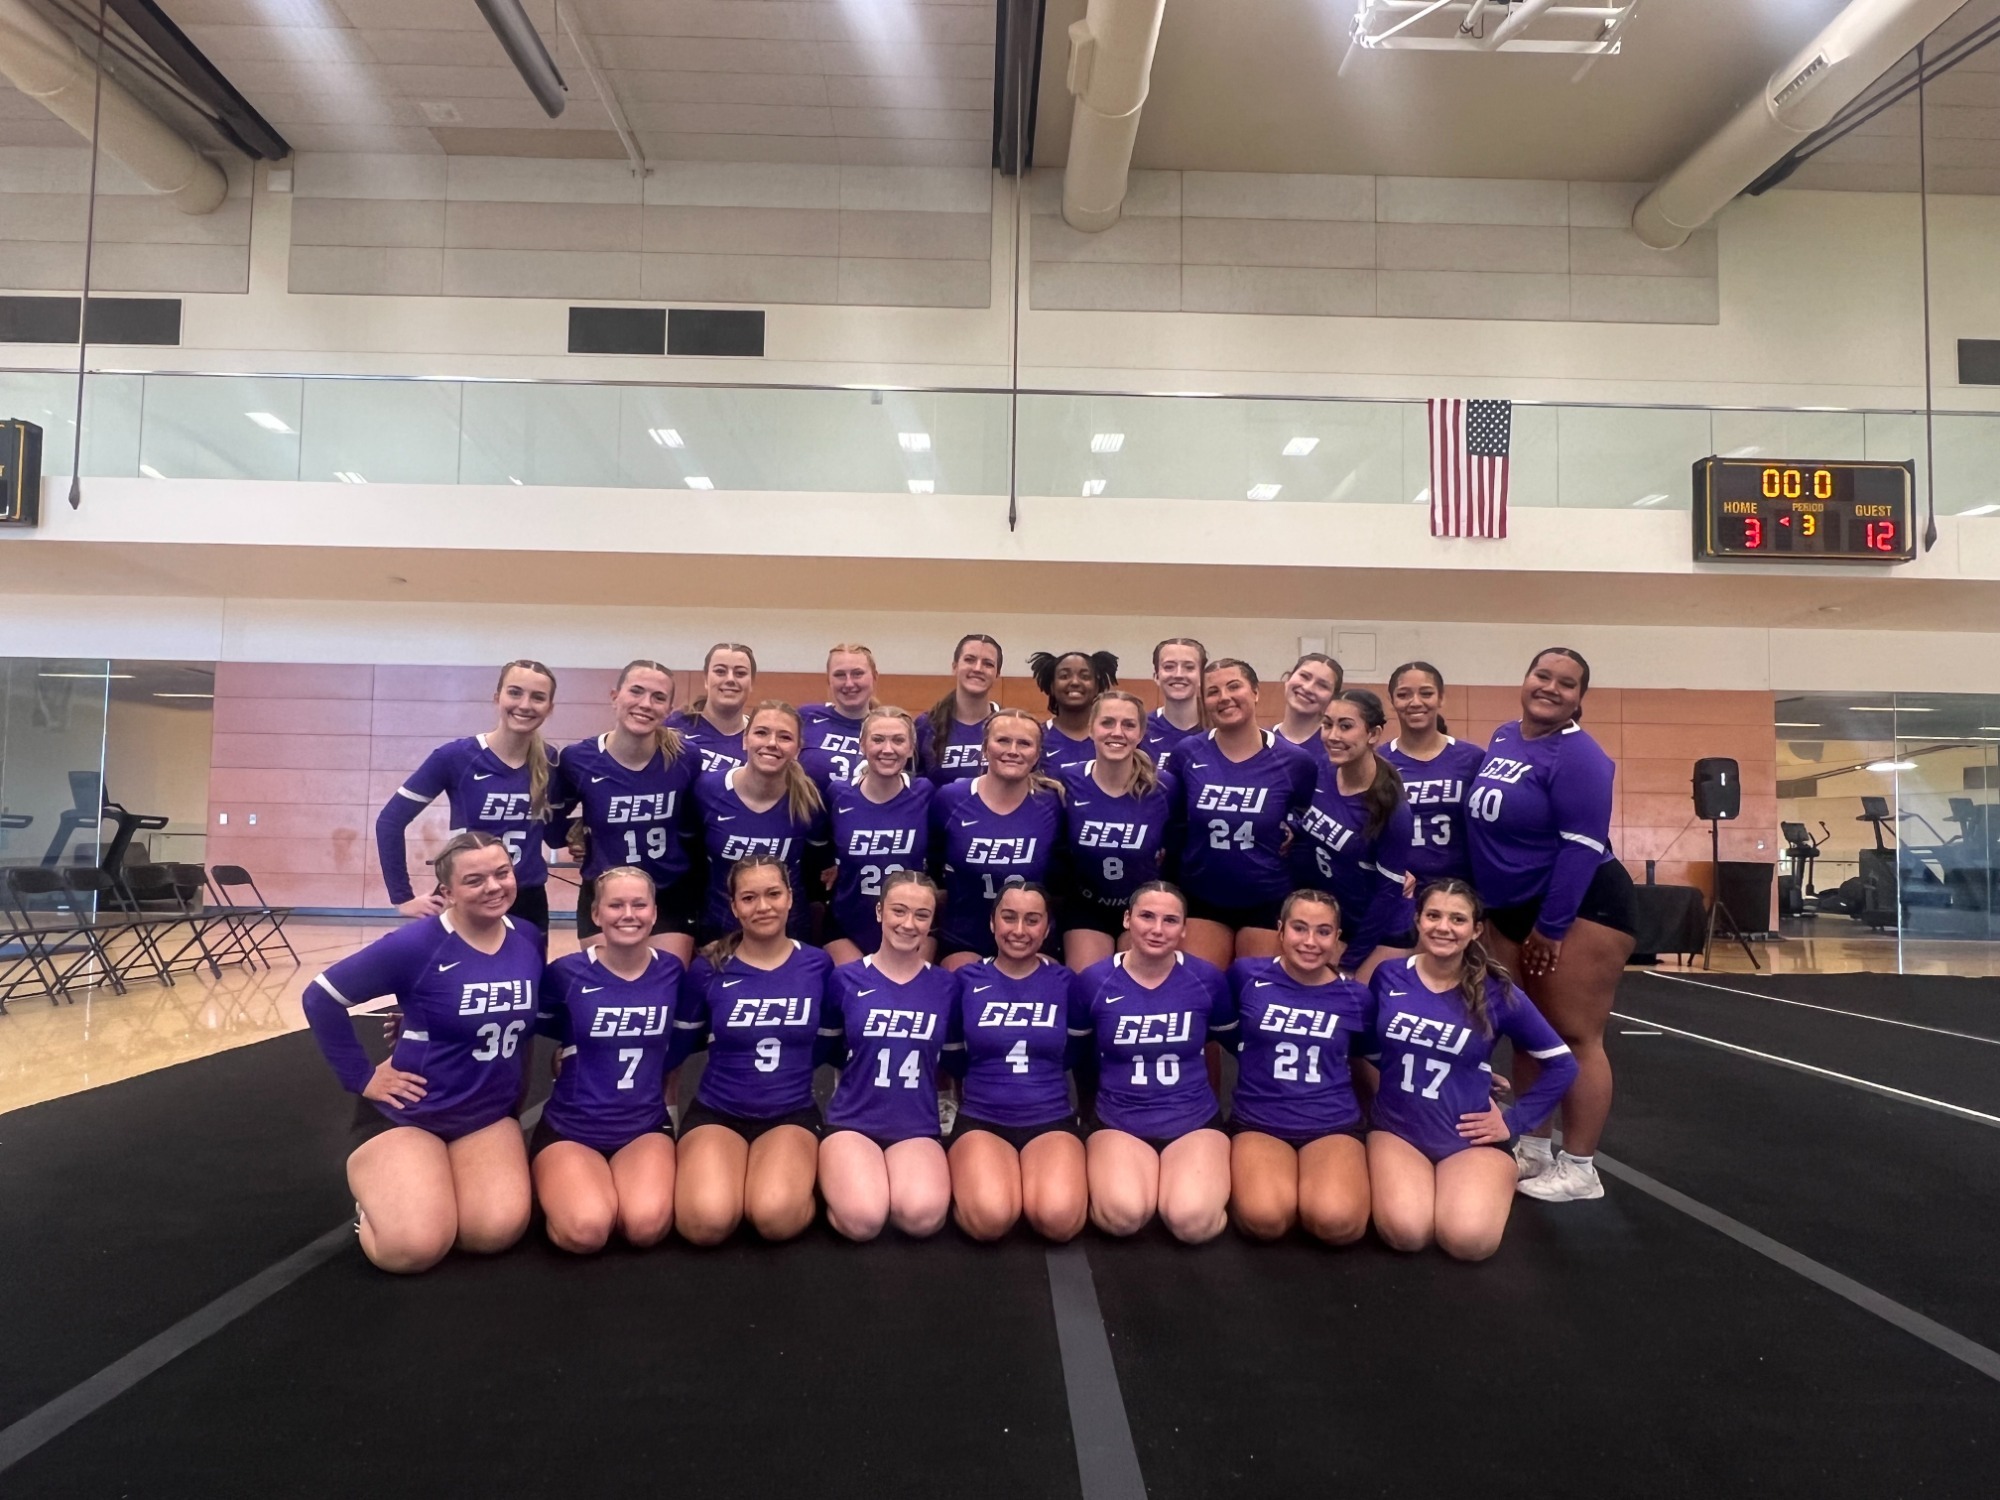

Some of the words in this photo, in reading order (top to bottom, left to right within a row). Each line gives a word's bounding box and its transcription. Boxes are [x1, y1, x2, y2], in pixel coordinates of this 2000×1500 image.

[1763, 469, 1831, 498] 00:0
[1723, 501, 1757, 514] HOME
[1792, 503, 1824, 512] PERIOD
[1855, 504, 1892, 516] GUEST
[1745, 518, 1760, 548] 3
[1803, 514, 1815, 535] 3
[1867, 521, 1894, 550] 12
[820, 733, 864, 757] GC
[941, 744, 989, 768] GC
[1479, 757, 1533, 784] GCU
[479, 793, 533, 820] GC
[608, 791, 676, 822] GCU
[1196, 784, 1268, 813] GCU
[1403, 779, 1462, 804] GCU
[1468, 786, 1503, 822] 40
[849, 829, 916, 855] GCU
[1078, 821, 1148, 849] GCU
[1208, 819, 1255, 850] 24
[1302, 805, 1354, 851] GCU
[1411, 814, 1451, 846] 13
[623, 828, 667, 863] 19
[966, 838, 1037, 864] GCU
[1103, 857, 1124, 880] 8
[1316, 847, 1333, 878] 6
[458, 979, 532, 1016] GCU
[727, 998, 812, 1027] GCU
[589, 1006, 669, 1037] GCU
[863, 1008, 938, 1040] GCU
[978, 1002, 1058, 1027] GCU
[1113, 1011, 1192, 1044] GCU
[1259, 1004, 1340, 1039] GCU
[472, 1020, 526, 1061] 36
[1386, 1012, 1472, 1056] GCU
[617, 1048, 644, 1090] 7
[755, 1038, 781, 1072] 9
[874, 1048, 920, 1088] 14
[1006, 1040, 1029, 1073] 4
[1131, 1054, 1180, 1085] 10
[1273, 1042, 1321, 1083] 21
[1400, 1053, 1451, 1099] 17
